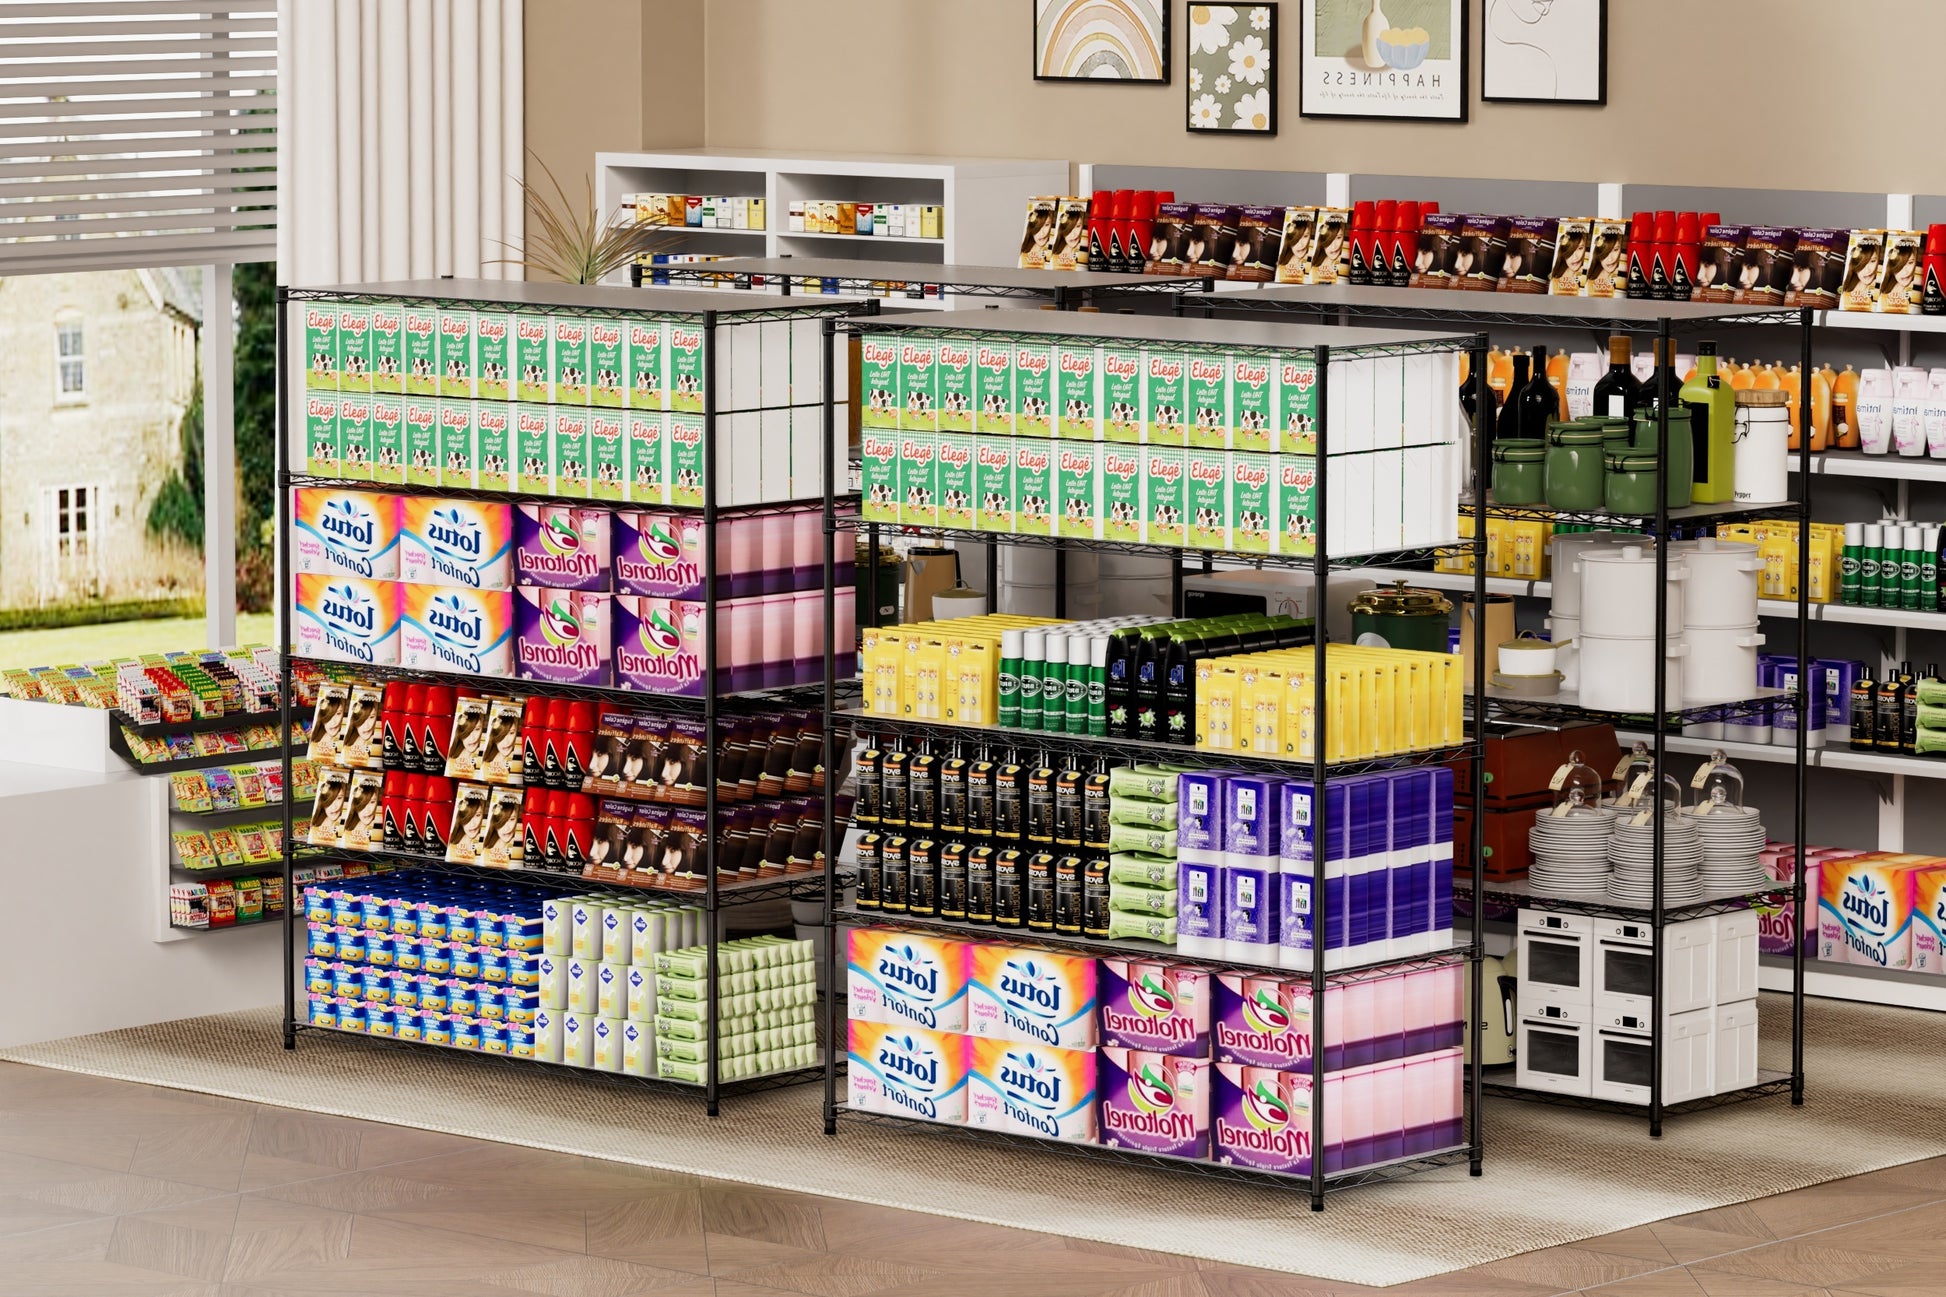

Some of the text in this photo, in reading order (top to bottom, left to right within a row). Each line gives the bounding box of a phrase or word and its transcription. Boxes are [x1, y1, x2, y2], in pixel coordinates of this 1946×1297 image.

[308, 312, 334, 334] Elegê
[341, 313, 367, 335] Elegê
[373, 313, 398, 335] Elegê
[407, 315, 432, 337] Elegê
[442, 317, 467, 340] Elegê
[479, 319, 505, 342] Elegê
[519, 321, 544, 344] Elegê
[557, 323, 583, 347] Elegê
[593, 325, 619, 349] Elegê
[631, 328, 658, 351] Elegê
[673, 330, 699, 353] Elegê
[864, 344, 894, 368] Elegê
[902, 346, 932, 371] Elegê
[940, 346, 969, 371] Elegê
[979, 348, 1007, 373] Elegê
[1018, 351, 1047, 375] Elegê
[1061, 353, 1090, 378] Elegê
[1106, 355, 1136, 380] Elegê
[1150, 358, 1180, 383] Elegê
[1191, 360, 1222, 386] Elegê
[1235, 363, 1267, 388] Elegê
[1283, 366, 1314, 391] Elegê
[309, 399, 335, 422] Elegê
[342, 401, 368, 424] Elegê
[374, 404, 399, 427] Elegê
[408, 407, 433, 429] Elegê
[443, 409, 468, 432] Elegê
[480, 411, 505, 434] Elegê
[519, 414, 545, 437] Elegê
[558, 416, 583, 440] Elegê
[593, 419, 620, 442] Elegê
[632, 421, 659, 445] Elegê
[673, 424, 700, 448] Elegê
[865, 439, 894, 463] Elegê
[902, 441, 932, 466] Elegê
[940, 444, 968, 469] Elegê
[979, 447, 1007, 471] Elegê
[1018, 449, 1047, 474] Elegê
[1061, 452, 1090, 477] Elegê
[1106, 455, 1136, 480] Elegê
[1150, 458, 1180, 483] Elegê
[1191, 461, 1221, 486] Elegê
[1235, 463, 1266, 489] Elegê
[1282, 467, 1313, 492] Elegê
